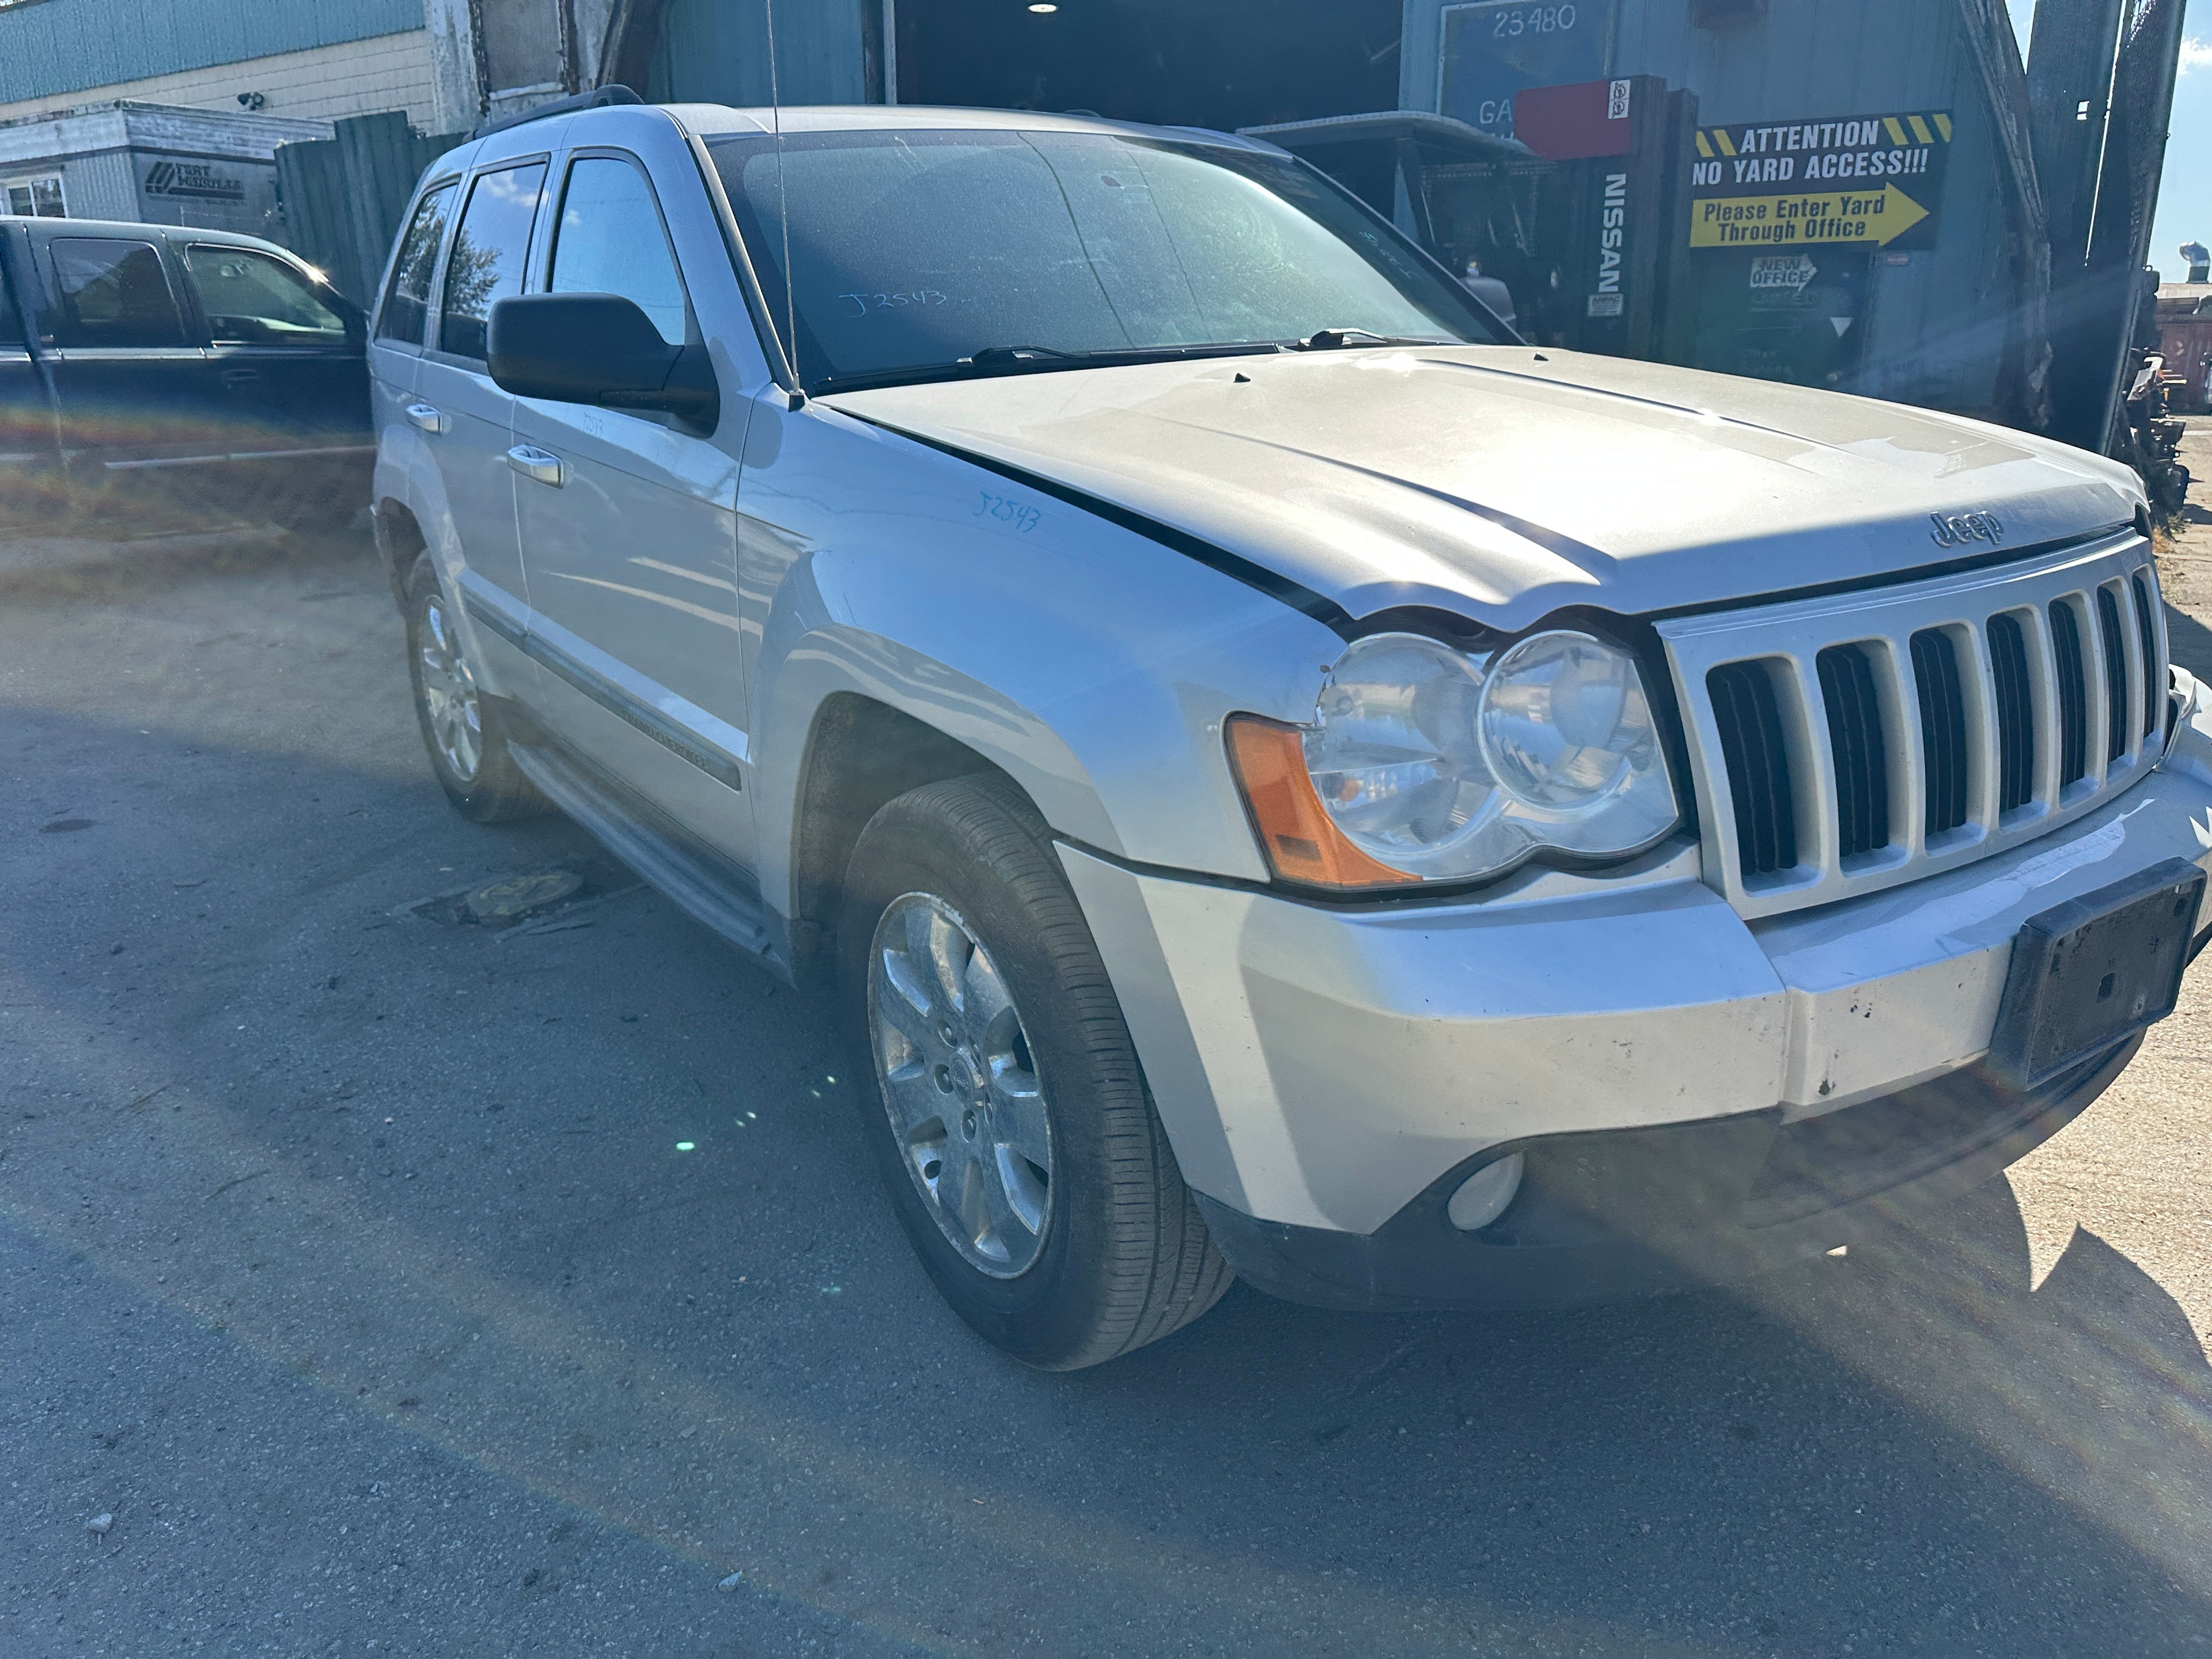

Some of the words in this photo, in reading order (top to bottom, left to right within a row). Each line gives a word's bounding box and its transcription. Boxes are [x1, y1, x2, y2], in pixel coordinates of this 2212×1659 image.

[1493, 5, 1575, 37] 23480
[1740, 120, 1879, 153] ATTENTION
[1692, 162, 1722, 185] NO
[1733, 156, 1794, 183] YARD
[1804, 149, 1928, 179] ACCESS!!!
[1704, 203, 1767, 222] Please
[1777, 199, 1830, 217] Enter
[1840, 194, 1885, 215] Yard
[1599, 173, 1626, 292] NISSAN
[1718, 221, 1796, 243] Through
[1805, 218, 1866, 238] Office
[1752, 271, 1808, 285] OFFICE
[1760, 259, 1800, 270] NEW
[839, 290, 946, 317] J2543
[972, 491, 1041, 533] J2543
[1930, 510, 2003, 548] Jeep
